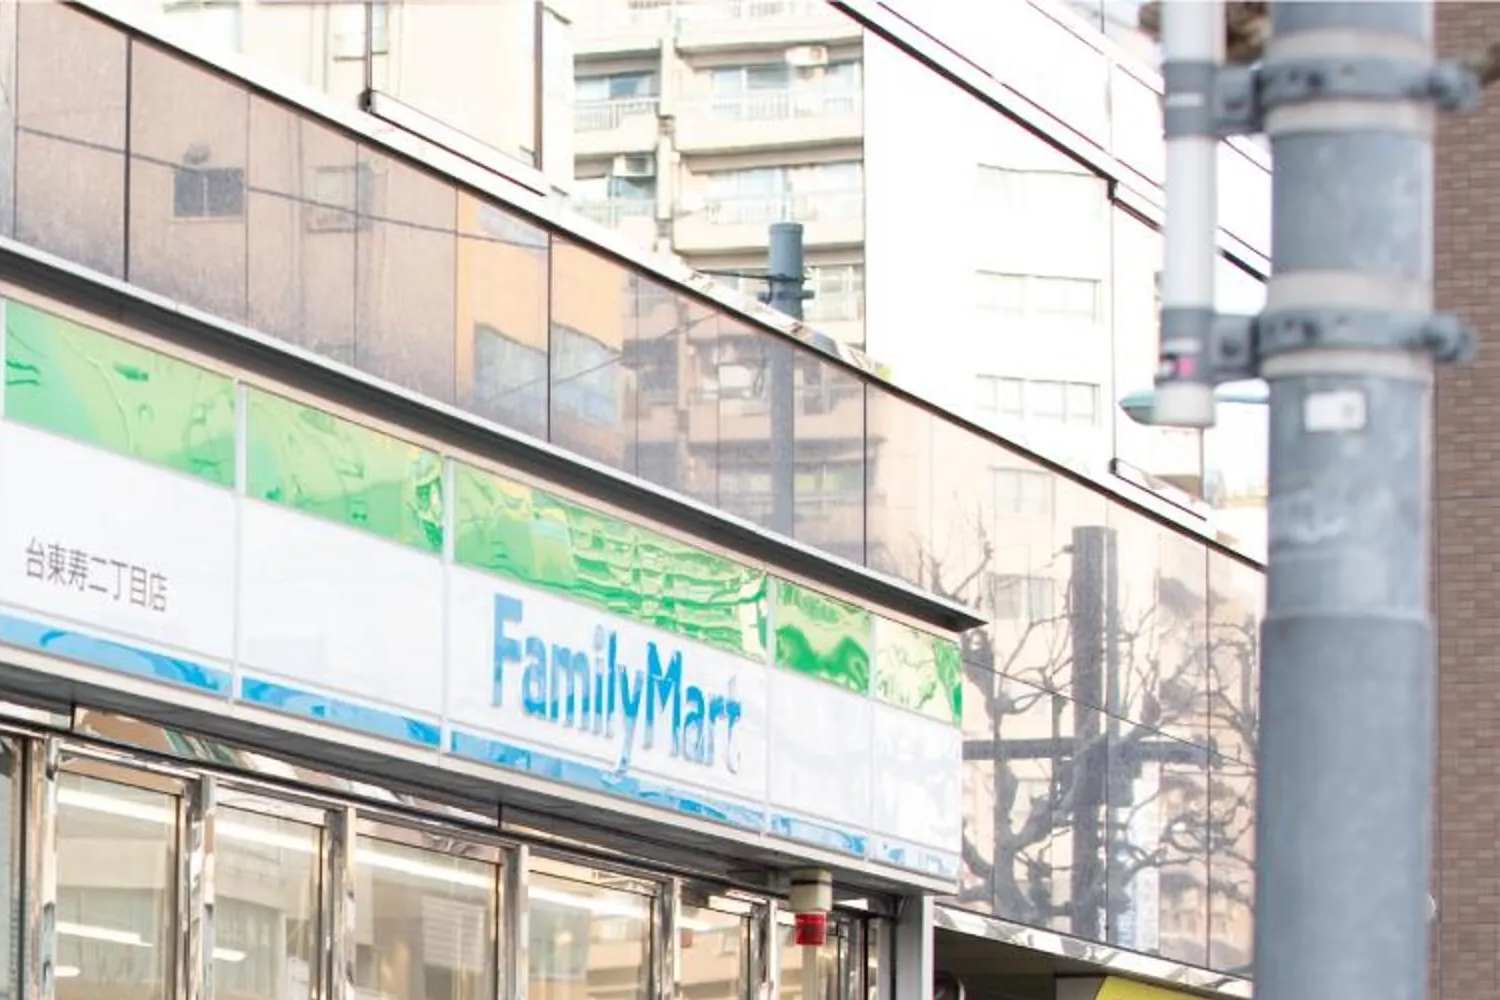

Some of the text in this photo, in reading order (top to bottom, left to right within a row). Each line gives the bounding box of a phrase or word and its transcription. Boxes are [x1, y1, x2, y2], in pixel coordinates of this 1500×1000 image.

[26, 537, 168, 612] 台東寿二丁目店
[491, 592, 743, 778] FamilyMart
